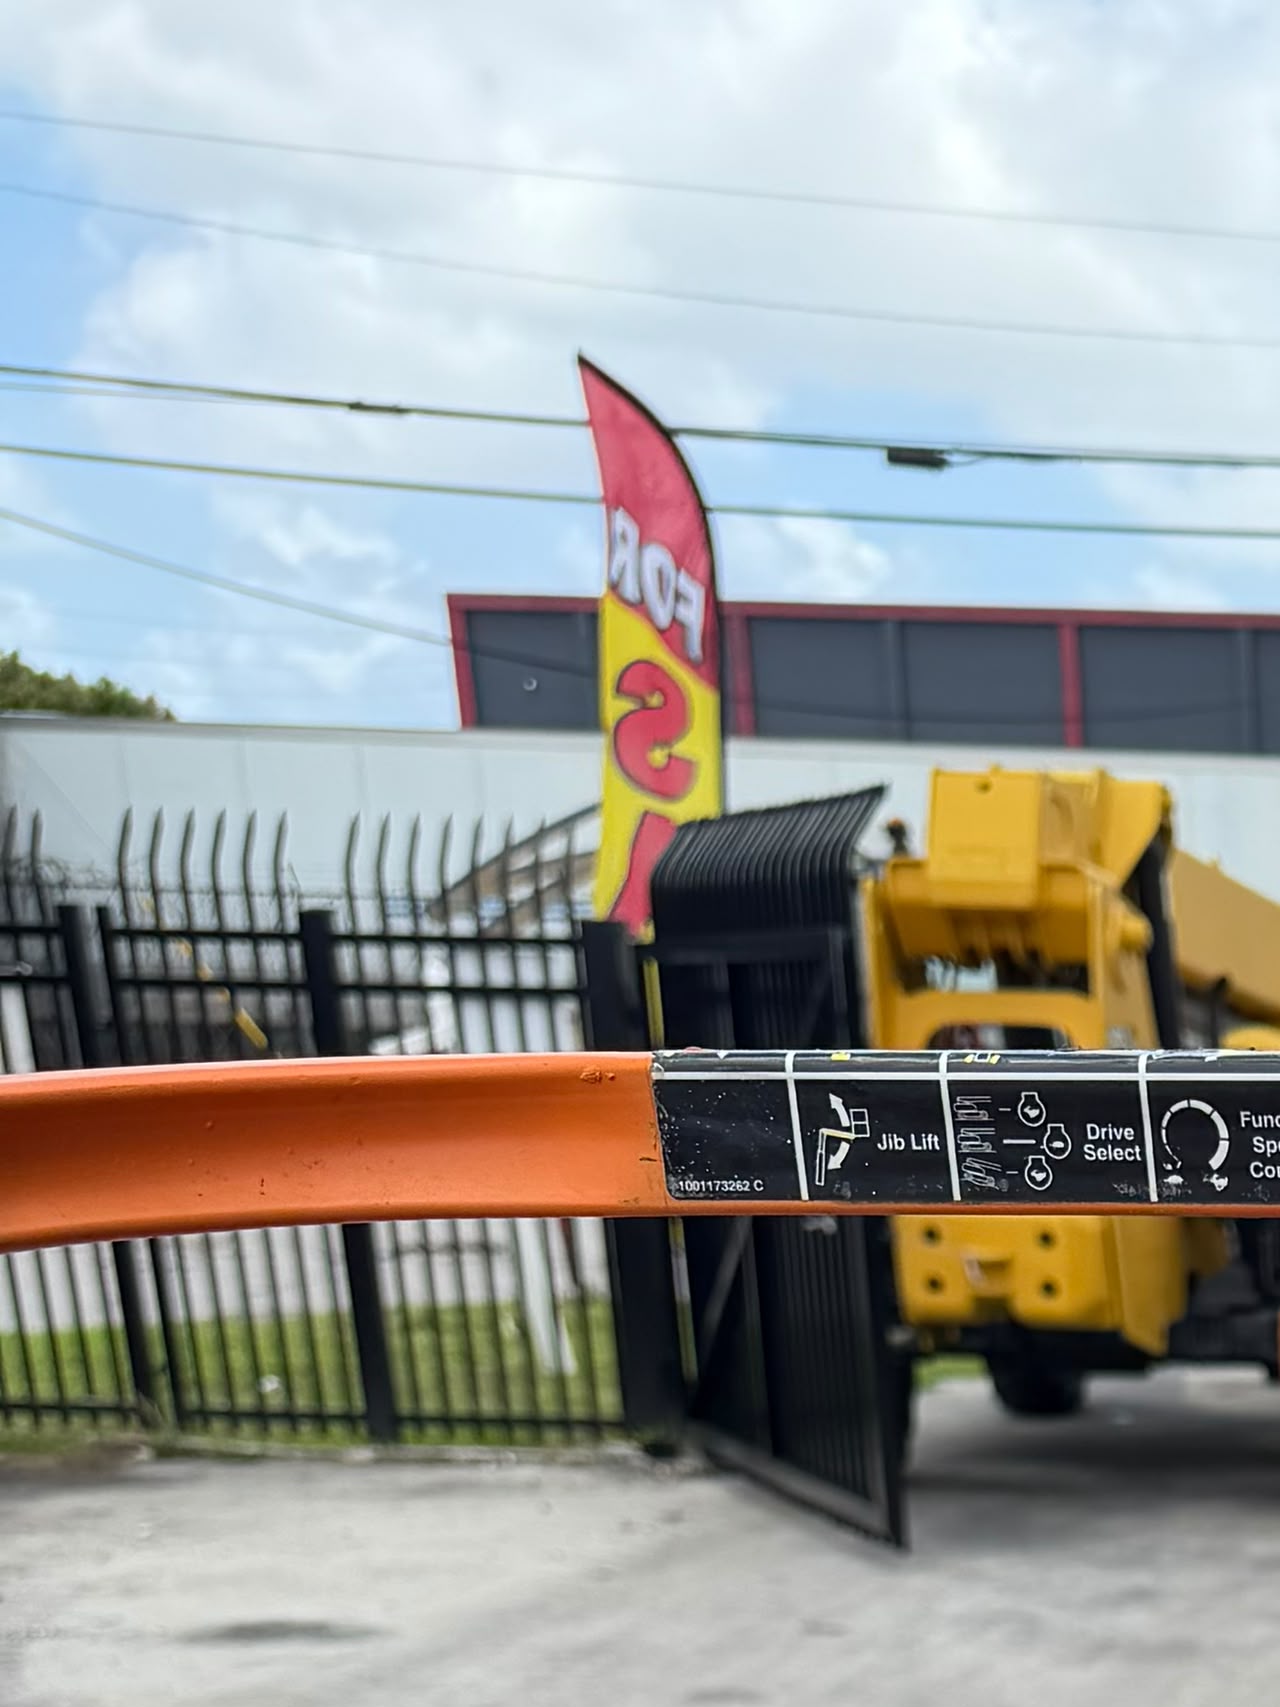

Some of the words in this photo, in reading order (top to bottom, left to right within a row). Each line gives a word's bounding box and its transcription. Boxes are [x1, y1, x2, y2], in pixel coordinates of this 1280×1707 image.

[1087, 1124, 1134, 1140] Drive
[878, 1134, 905, 1150] Jib
[911, 1134, 939, 1150] Lift
[1084, 1144, 1141, 1160] Select
[679, 1180, 750, 1191] 1001173262
[754, 1180, 763, 1191] C
